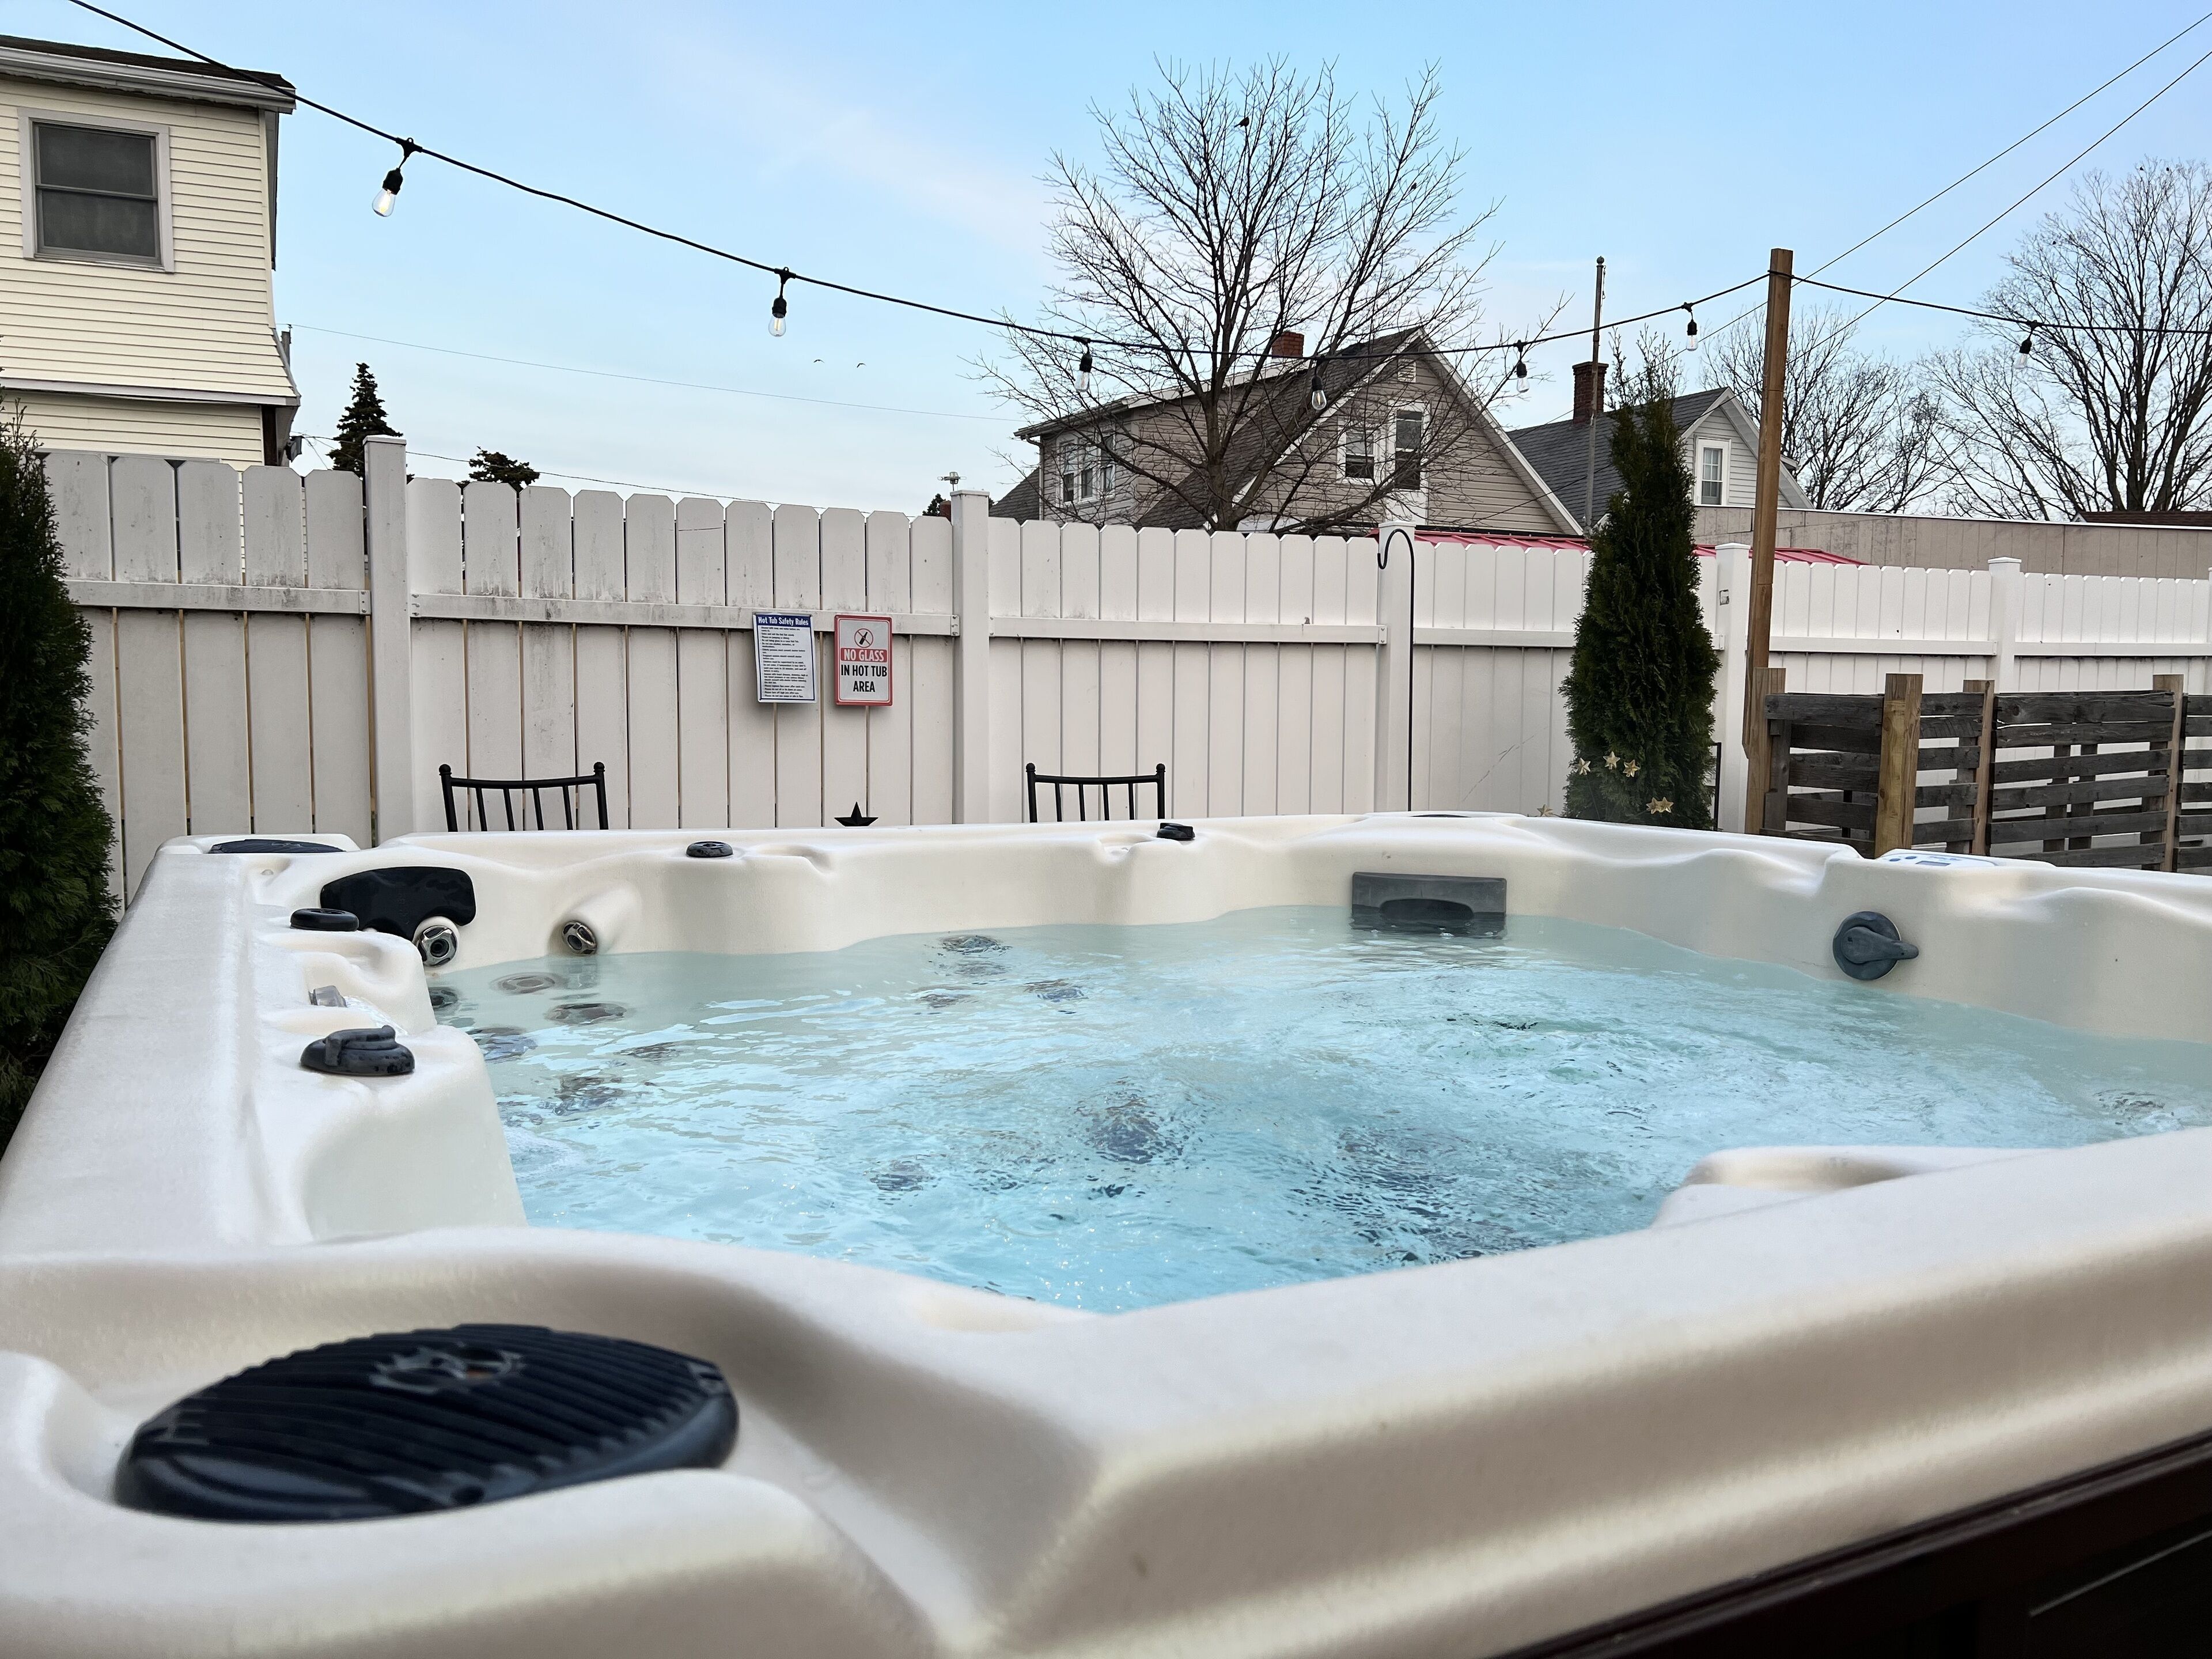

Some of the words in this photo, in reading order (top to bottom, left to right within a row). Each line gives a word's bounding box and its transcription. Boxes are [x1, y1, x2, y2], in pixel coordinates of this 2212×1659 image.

[778, 617, 794, 626] Safety
[795, 618, 809, 626] Rules
[844, 649, 857, 661] NO
[858, 649, 884, 662] GLASS
[841, 664, 850, 676] IN
[852, 665, 869, 676] HOT
[871, 665, 887, 677] TUB
[853, 680, 876, 692] AREA
